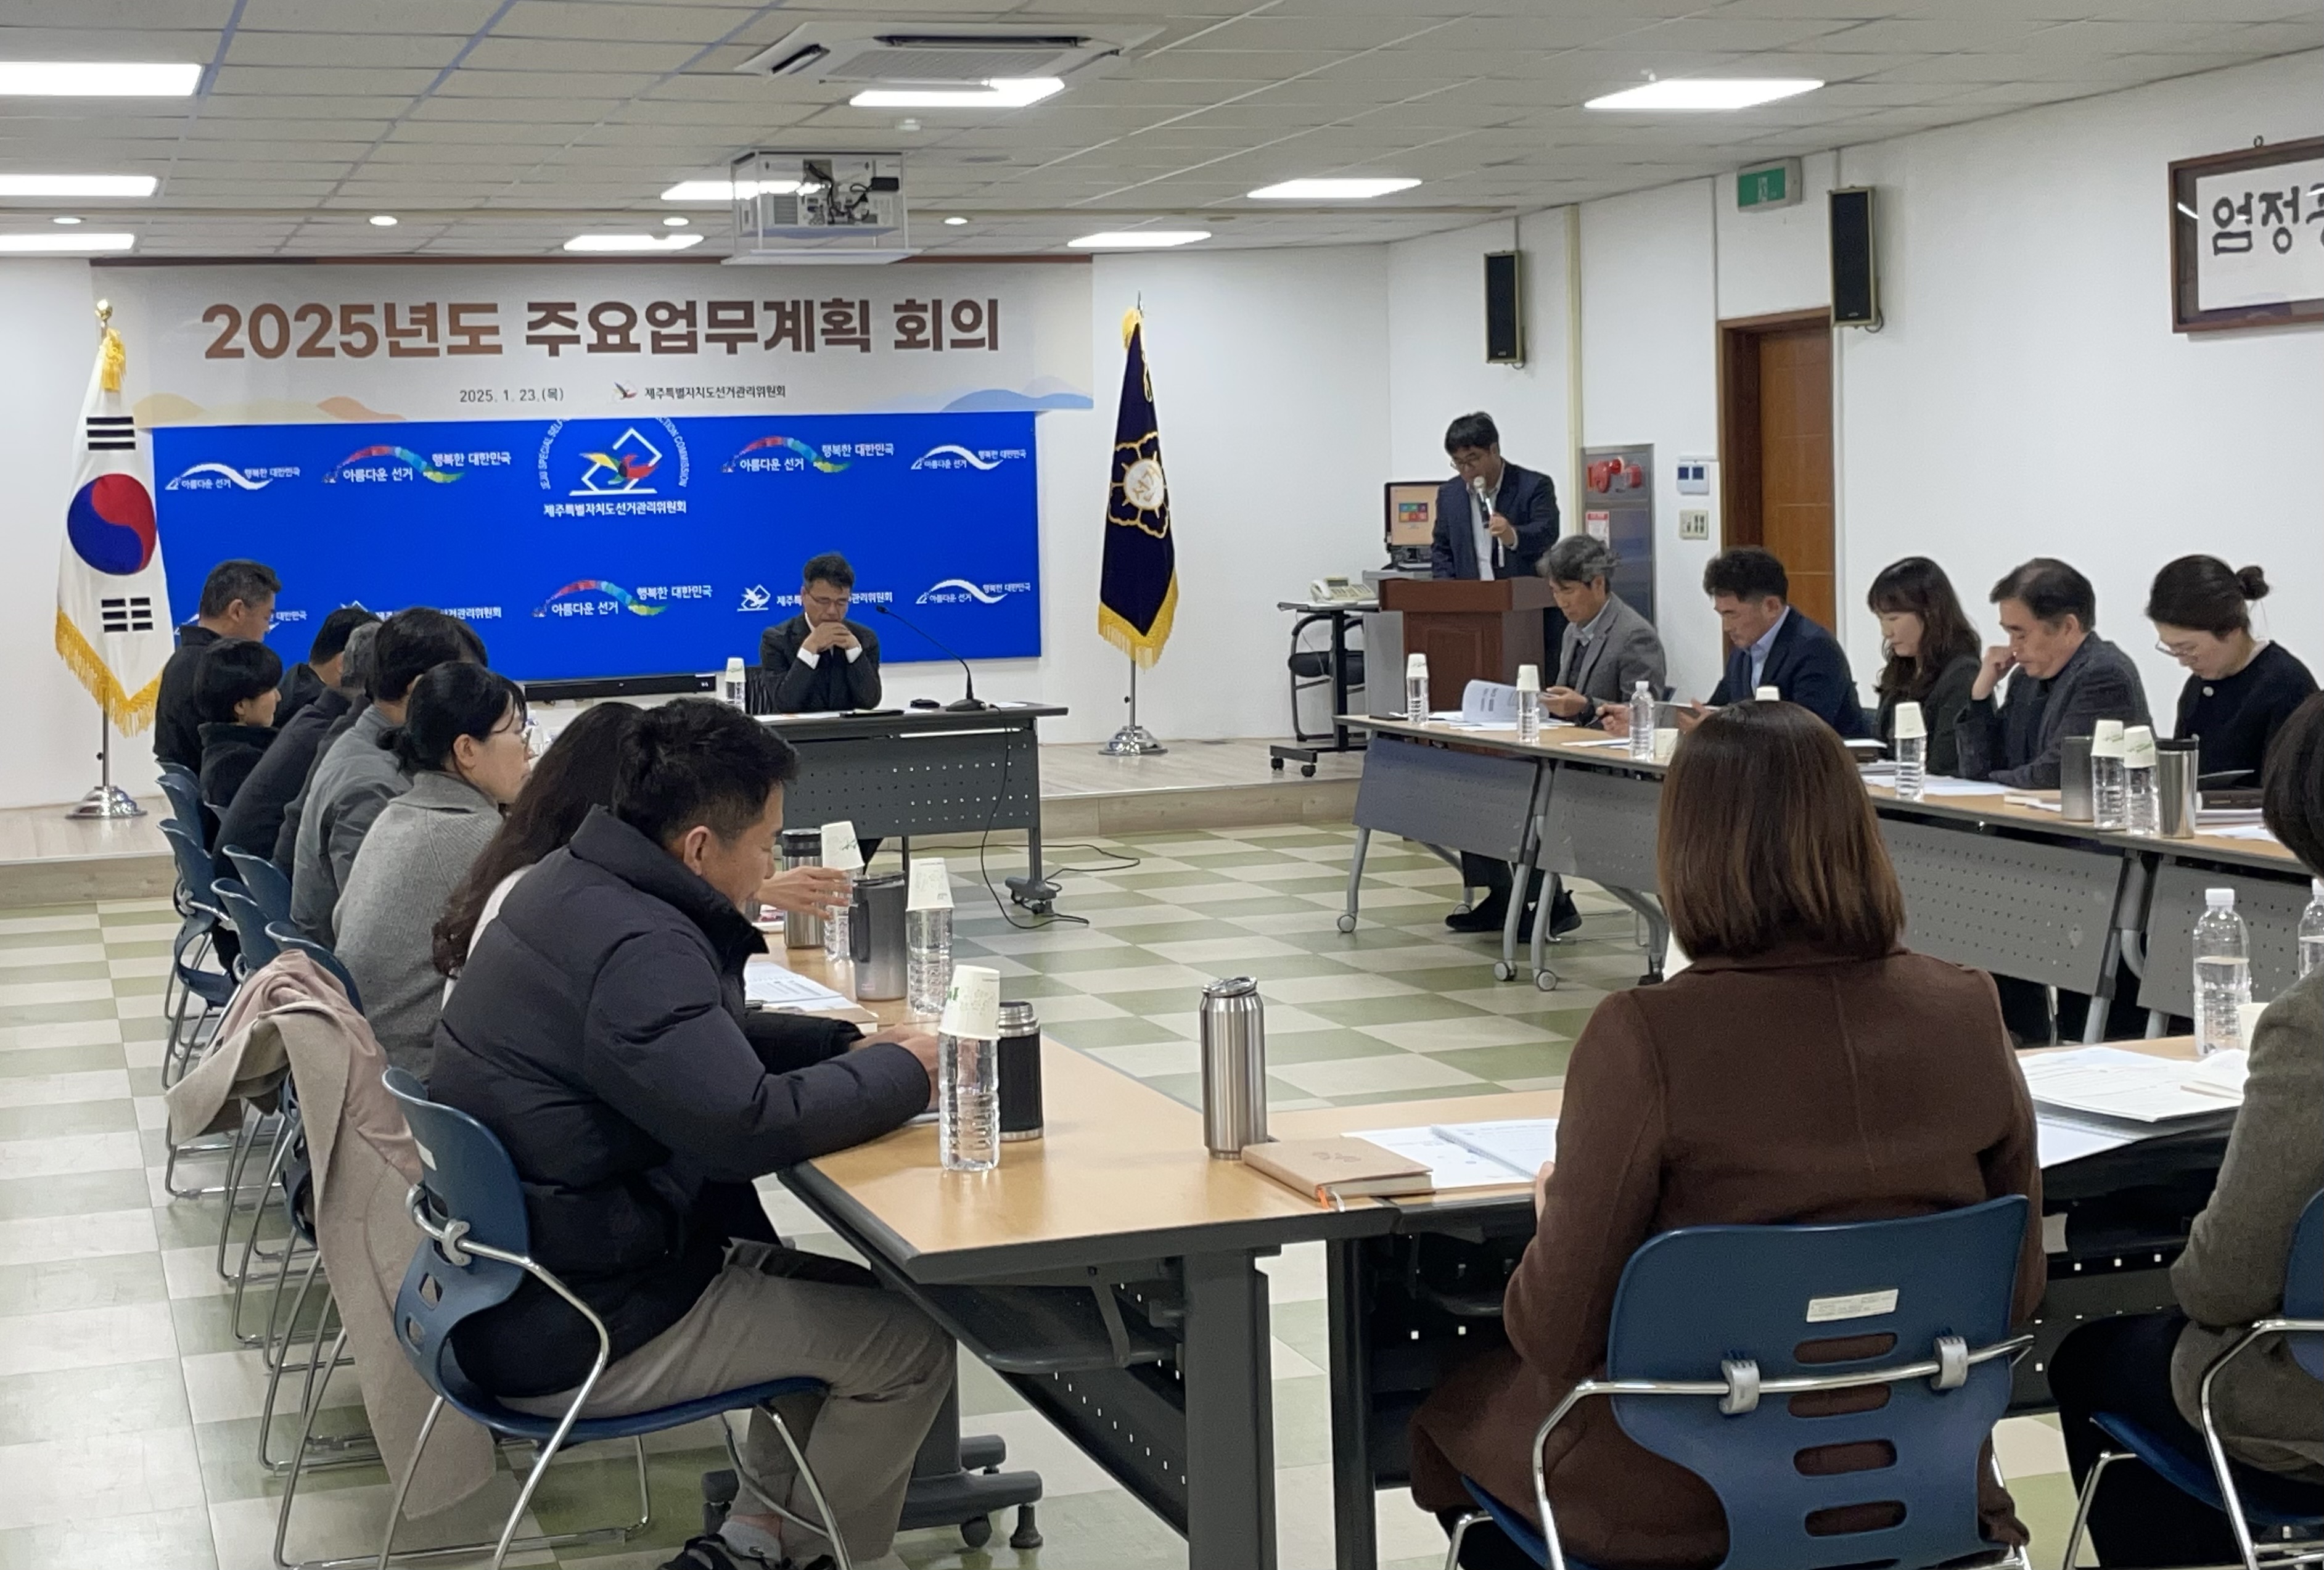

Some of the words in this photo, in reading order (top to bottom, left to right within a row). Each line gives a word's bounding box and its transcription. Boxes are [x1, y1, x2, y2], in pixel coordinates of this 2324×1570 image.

[202, 302, 503, 359] 2025년도
[525, 298, 871, 357] 주요업무계획
[893, 298, 998, 351] 회의
[459, 389, 498, 403] 2025.
[503, 389, 514, 402] 1.
[645, 385, 786, 399] 제주특별자치도선거관리위원회
[822, 443, 852, 458] 행복한
[855, 443, 893, 457] 대한민국
[432, 453, 465, 467] 행복한
[468, 451, 512, 466] 대한민국
[738, 458, 781, 472] 아름다운
[784, 458, 804, 471] 선거
[343, 468, 388, 483] 아름다운
[392, 467, 413, 482] 선거
[215, 479, 231, 489] 선거
[543, 499, 687, 517] 제주특별자치도선거관리위원회
[636, 586, 668, 601] 행복한
[671, 585, 713, 599] 대한민국
[551, 601, 595, 617] 아름다운
[597, 601, 618, 615] 선거
